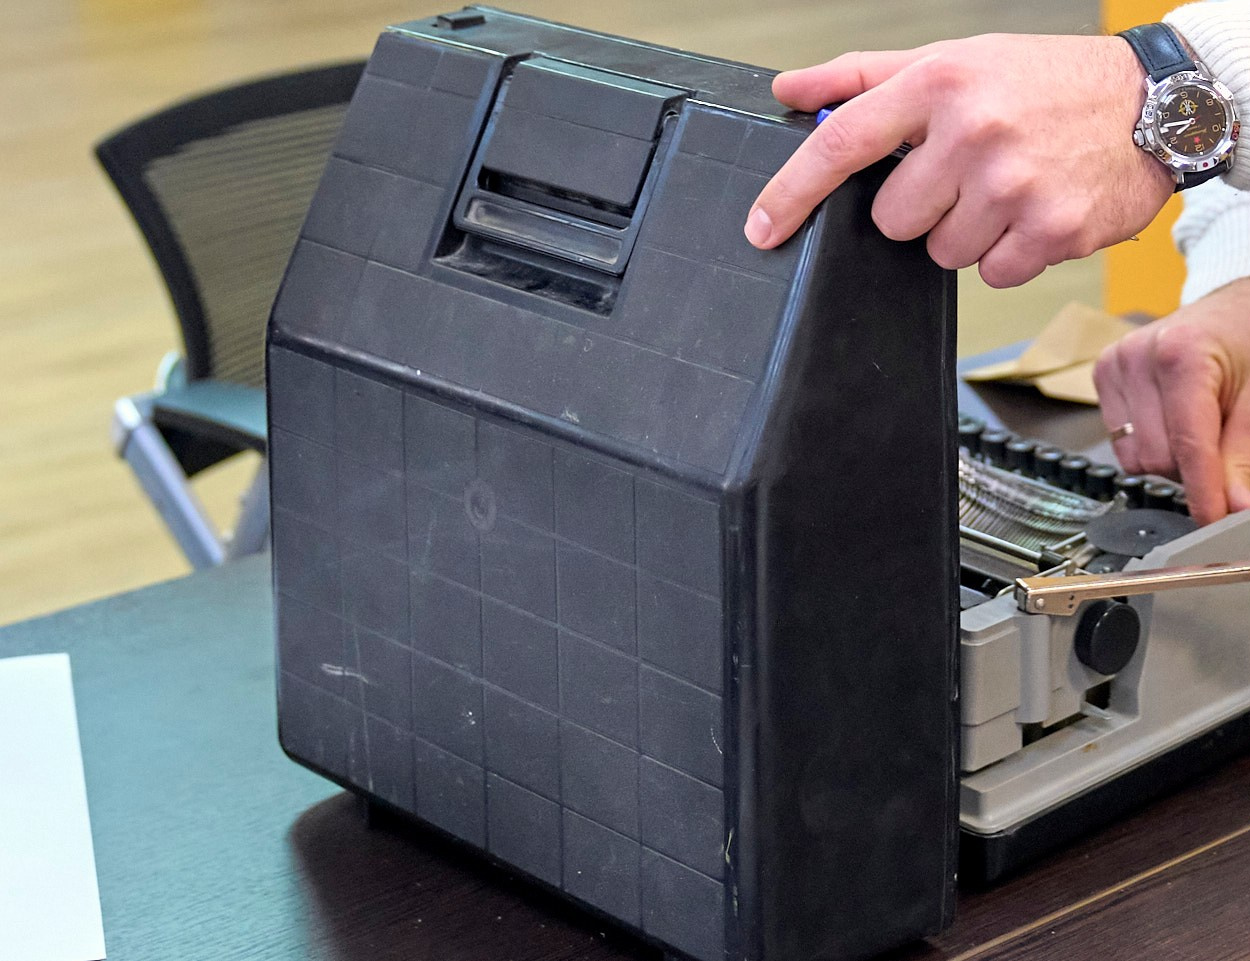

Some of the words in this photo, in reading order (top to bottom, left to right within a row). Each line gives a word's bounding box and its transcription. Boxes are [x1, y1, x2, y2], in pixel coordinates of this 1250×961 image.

[1180, 91, 1188, 99] 6
[1206, 98, 1214, 106] 8
[1212, 123, 1222, 132] 10
[1170, 136, 1178, 145] 2
[1194, 144, 1205, 152] 12
